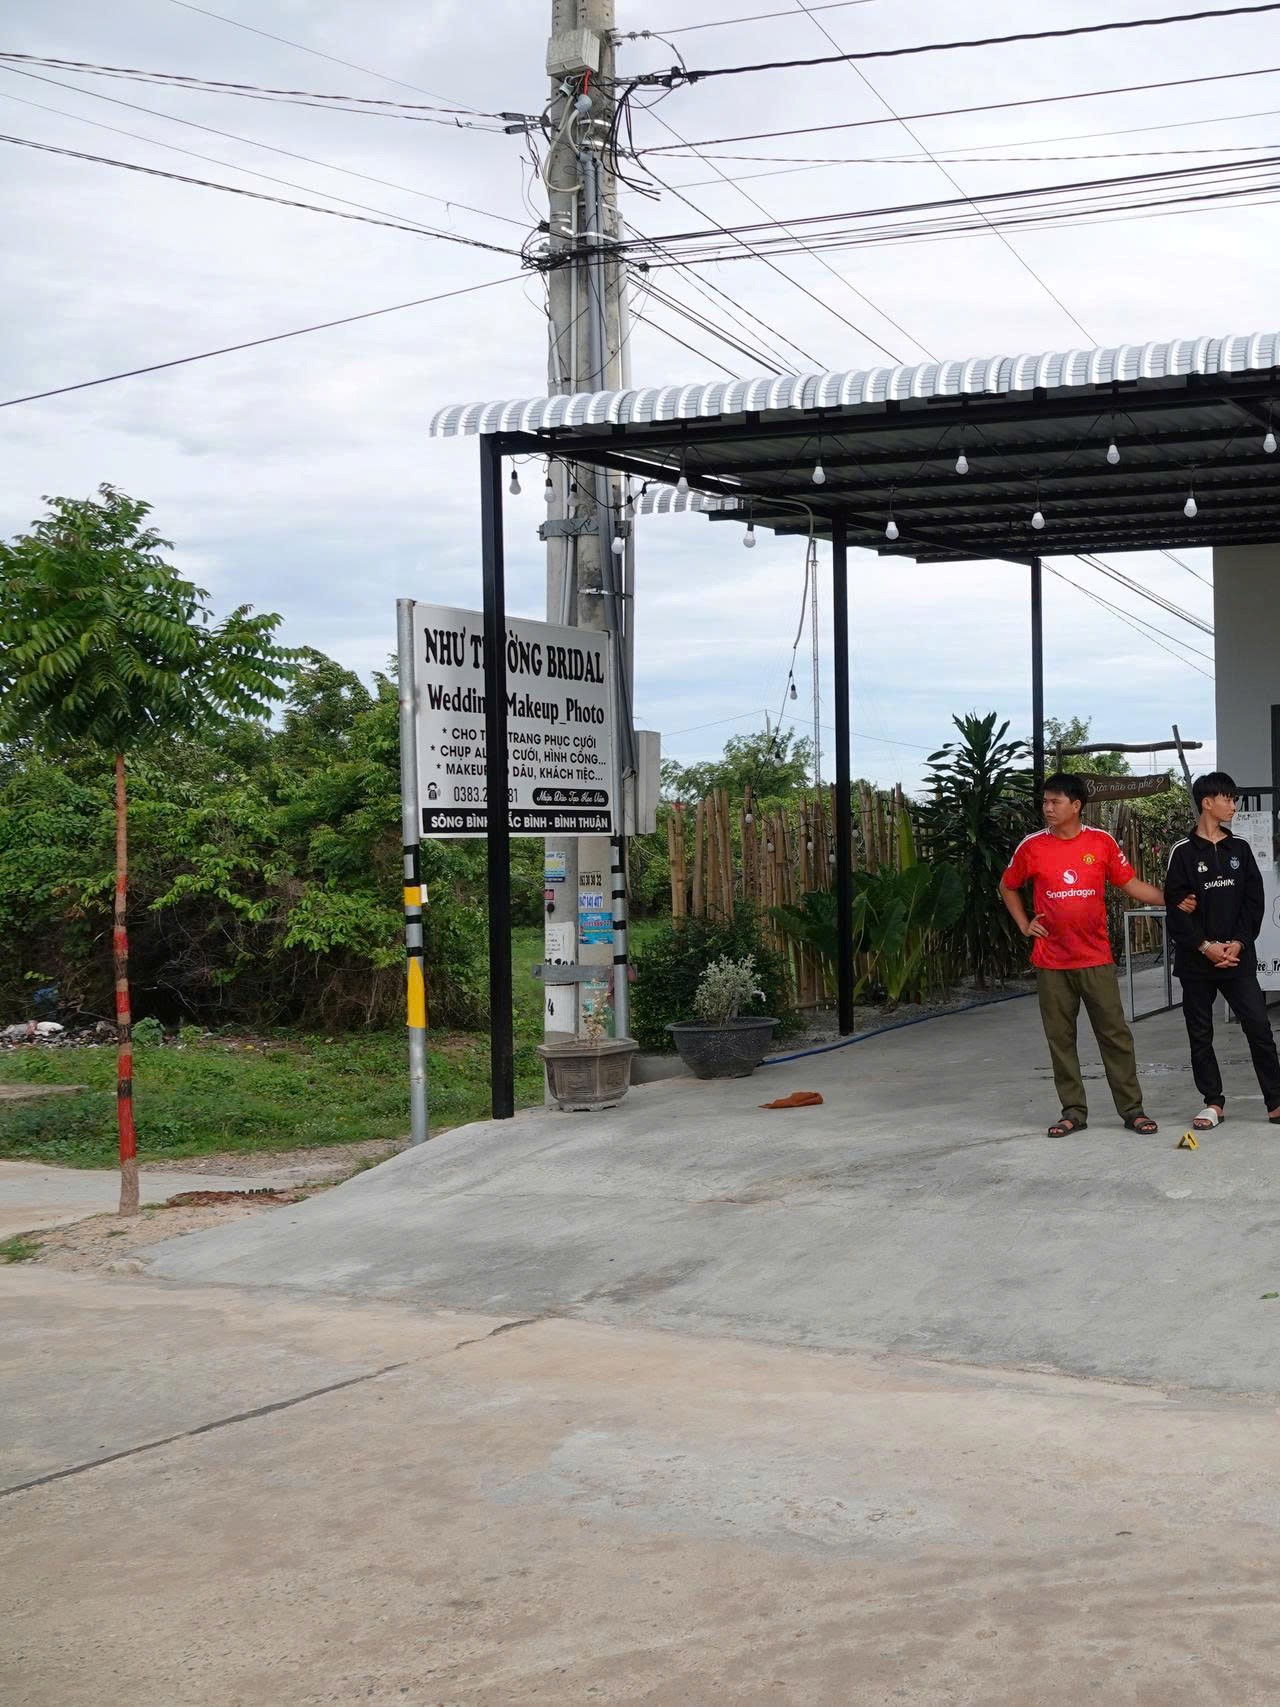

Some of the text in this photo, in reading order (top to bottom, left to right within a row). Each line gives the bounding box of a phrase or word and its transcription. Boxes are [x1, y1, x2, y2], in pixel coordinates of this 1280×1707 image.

[424, 627, 605, 684] NHƯ TỜNG BRIDAL
[427, 684, 487, 714] Weddin
[452, 728, 477, 741] CHO
[508, 732, 541, 744] TRANG
[544, 735, 570, 749] PHỤC
[573, 735, 596, 749] CƯỚI
[440, 745, 471, 760] CHỤP
[513, 747, 541, 763] CƯỚI,
[544, 749, 567, 763] HÌNH
[513, 764, 536, 780] DÂU,
[540, 766, 574, 779] KHÁCH
[431, 812, 464, 828] SÔNG
[524, 814, 547, 828] BÌNH
[554, 814, 577, 828] BÌNH
[578, 815, 608, 831] THUẬN
[1046, 888, 1096, 900] Snapdragon
